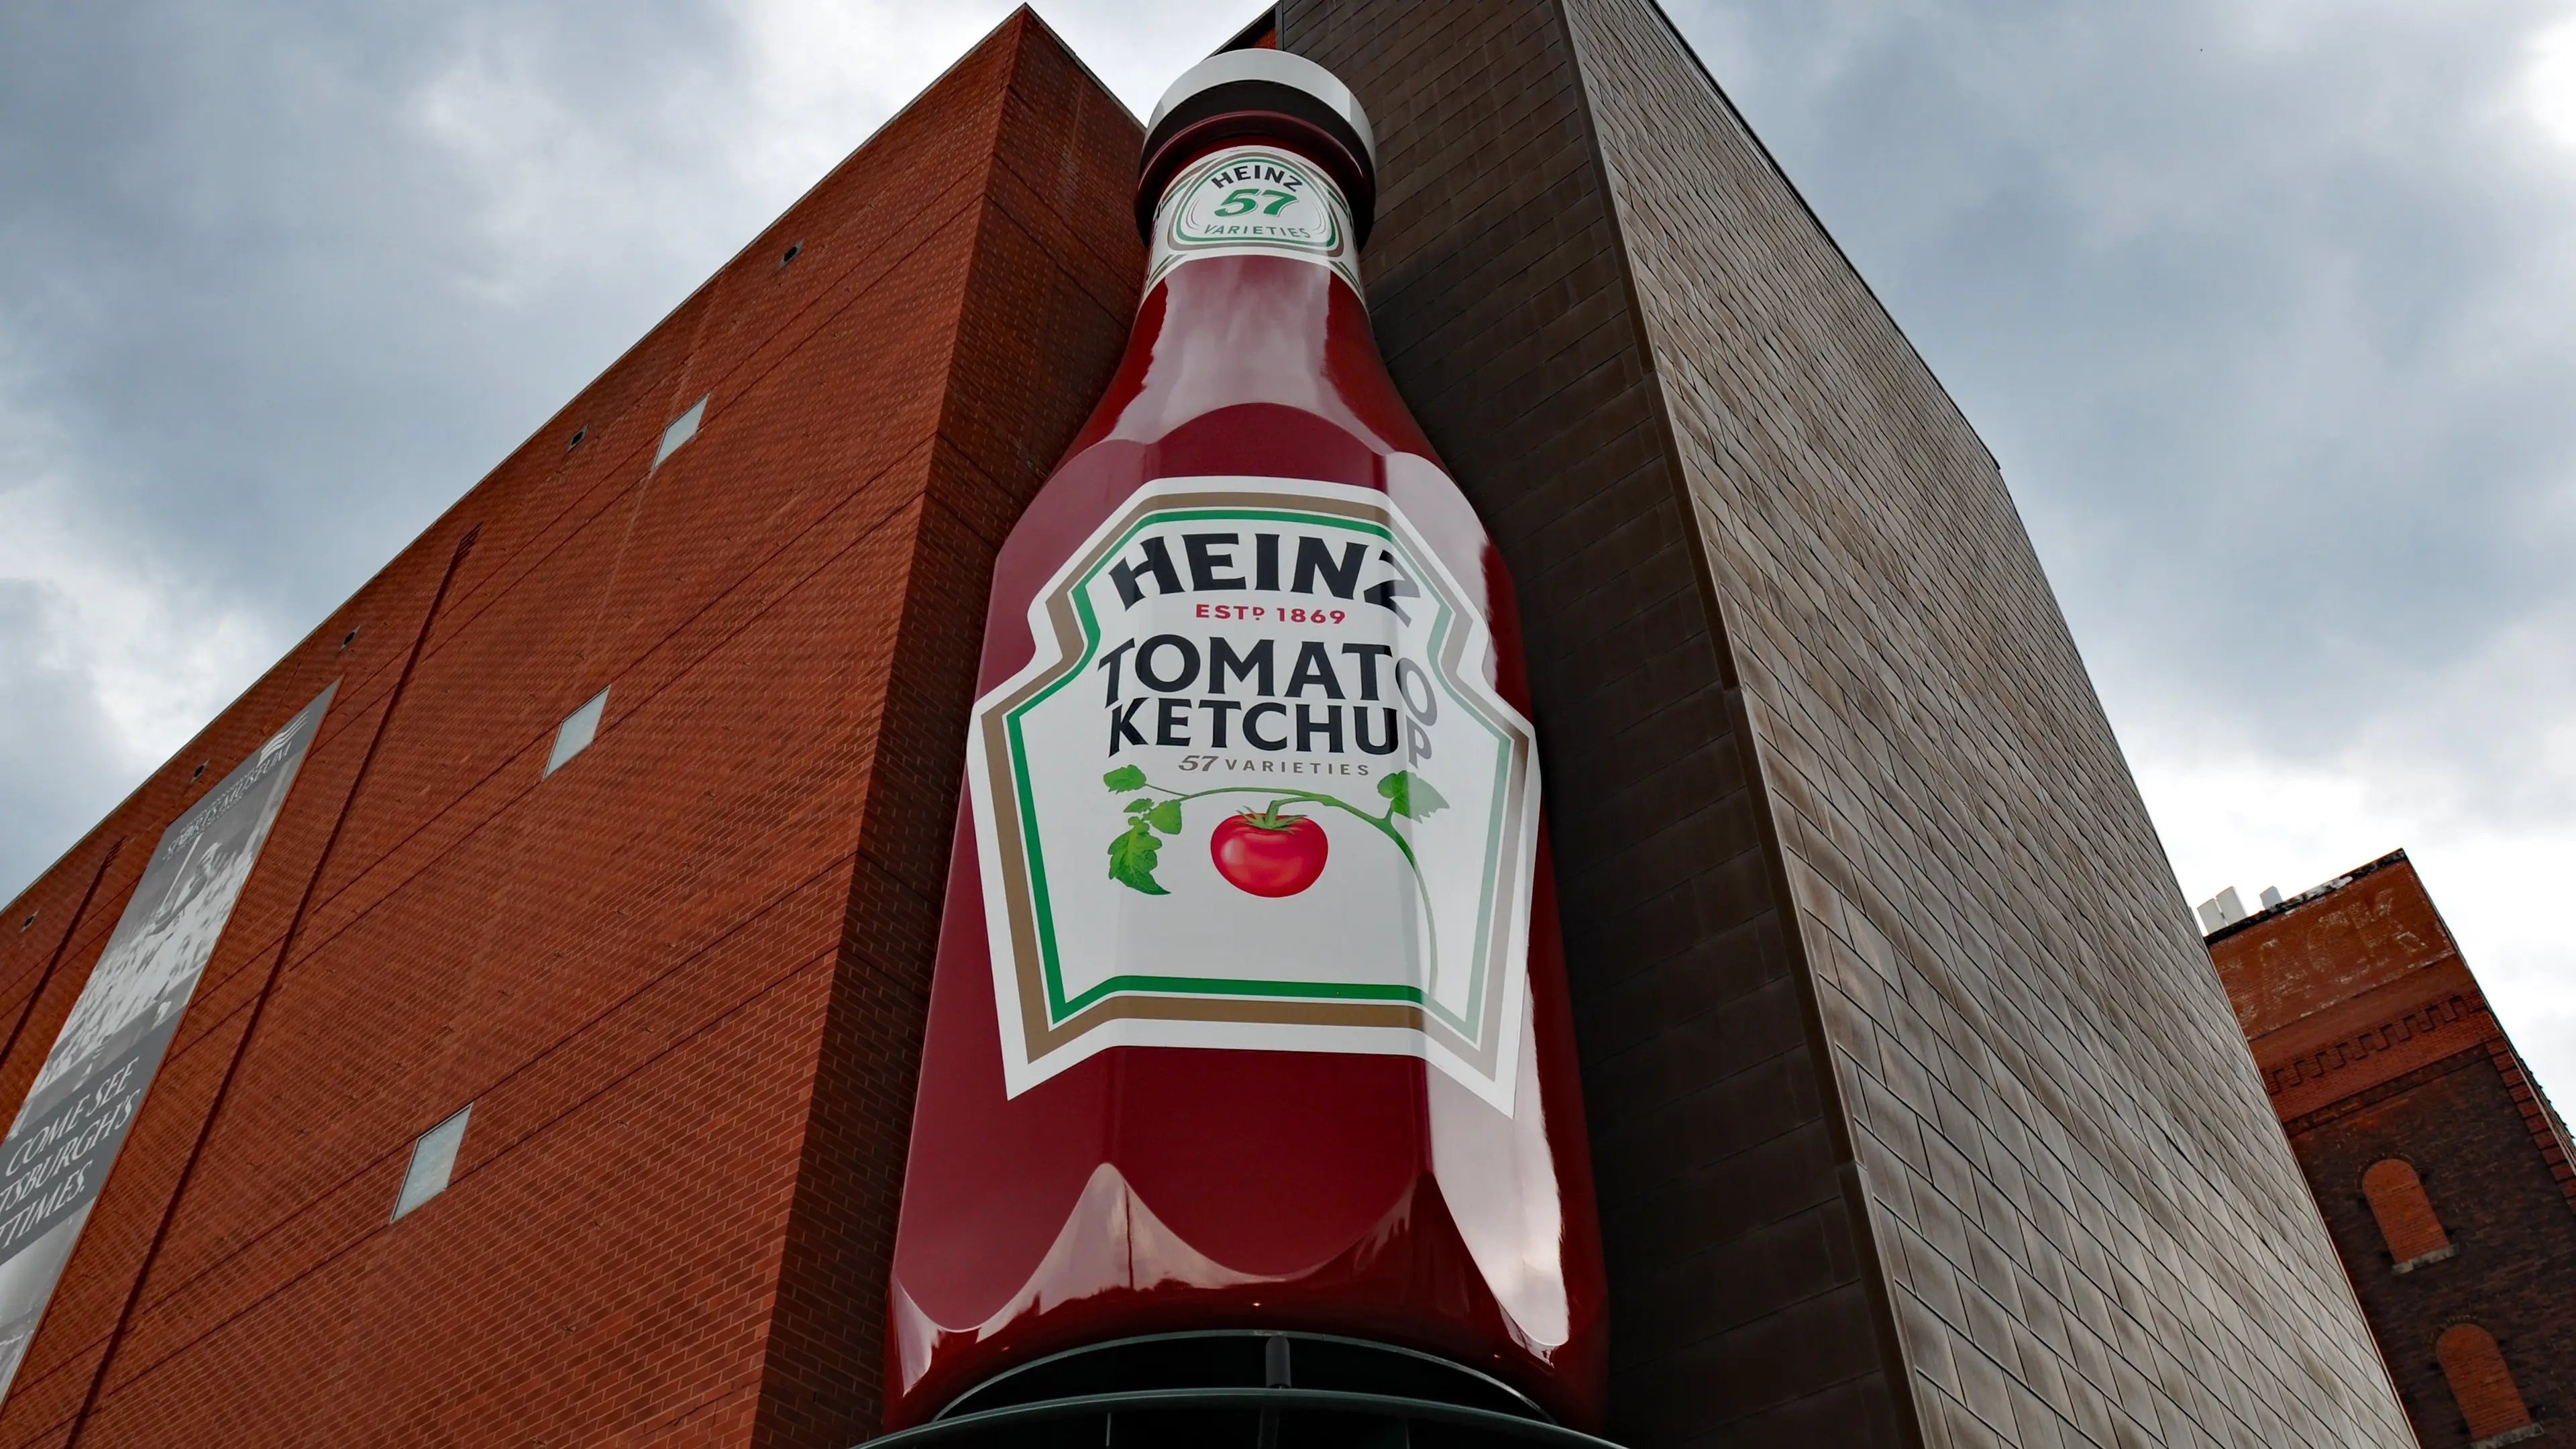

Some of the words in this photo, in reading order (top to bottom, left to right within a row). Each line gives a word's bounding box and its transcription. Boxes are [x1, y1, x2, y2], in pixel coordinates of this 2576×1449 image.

[1210, 164, 1303, 193] HEINZ
[1214, 188, 1299, 217] 57
[1203, 224, 1311, 239] VARIETIES
[1108, 533, 1421, 628] HEINZ
[1277, 607, 1346, 625] 1869
[1097, 634, 1438, 728] TOMATO
[1108, 698, 1432, 769] KETCHUP
[1178, 755, 1219, 772] 57
[1224, 759, 1370, 776] VARIETIES
[6, 1093, 91, 1177] COME
[87, 1056, 140, 1118] SEE
